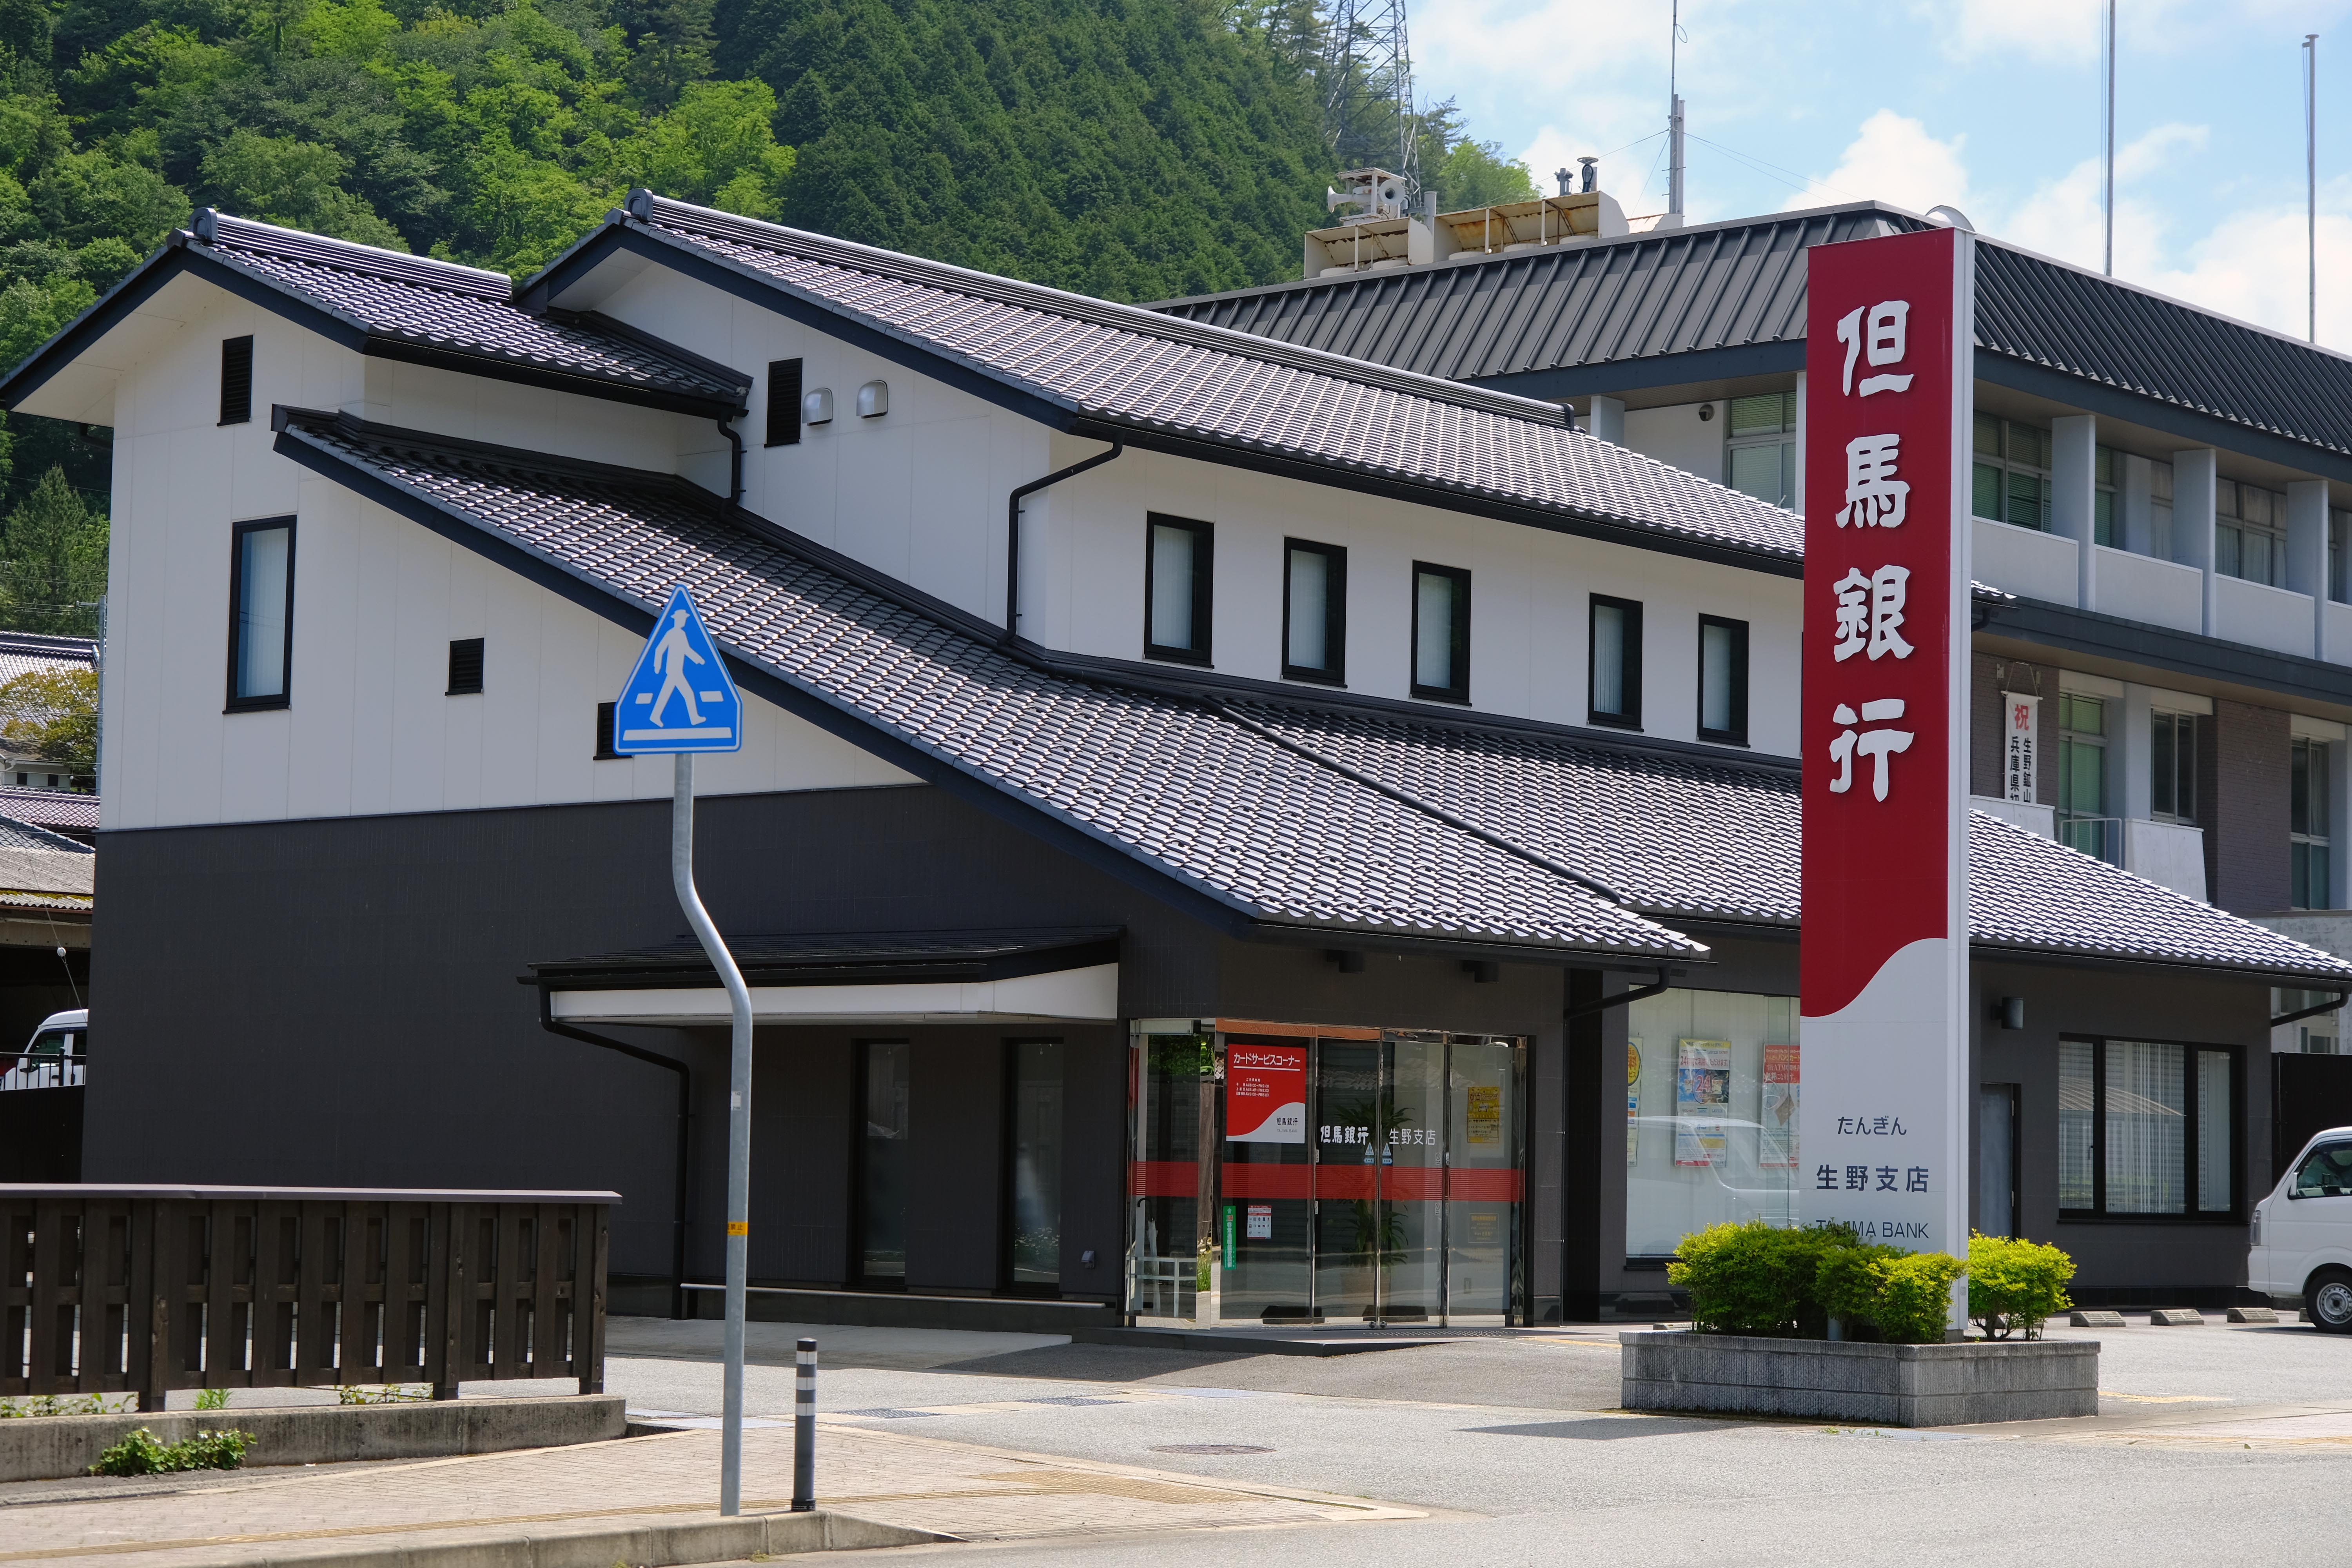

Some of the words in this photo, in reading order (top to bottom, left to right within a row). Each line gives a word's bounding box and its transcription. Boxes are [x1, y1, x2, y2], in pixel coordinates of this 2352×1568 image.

[1829, 299, 1915, 803] 但馬銀行
[2014, 704, 2029, 731] 祝
[1234, 1053, 1300, 1066] カードサービスコーナー
[1695, 1075, 1711, 1093] 24
[1277, 1118, 1298, 1126] 但馬銀行
[1838, 1115, 1907, 1136] たんぎん
[1320, 1125, 1369, 1145] 但馬銀行
[1389, 1128, 1436, 1145] 生野支店
[1817, 1164, 1929, 1193] 生野支店
[1816, 1220, 1877, 1237] TIMA
[1883, 1222, 1929, 1239] BANK
